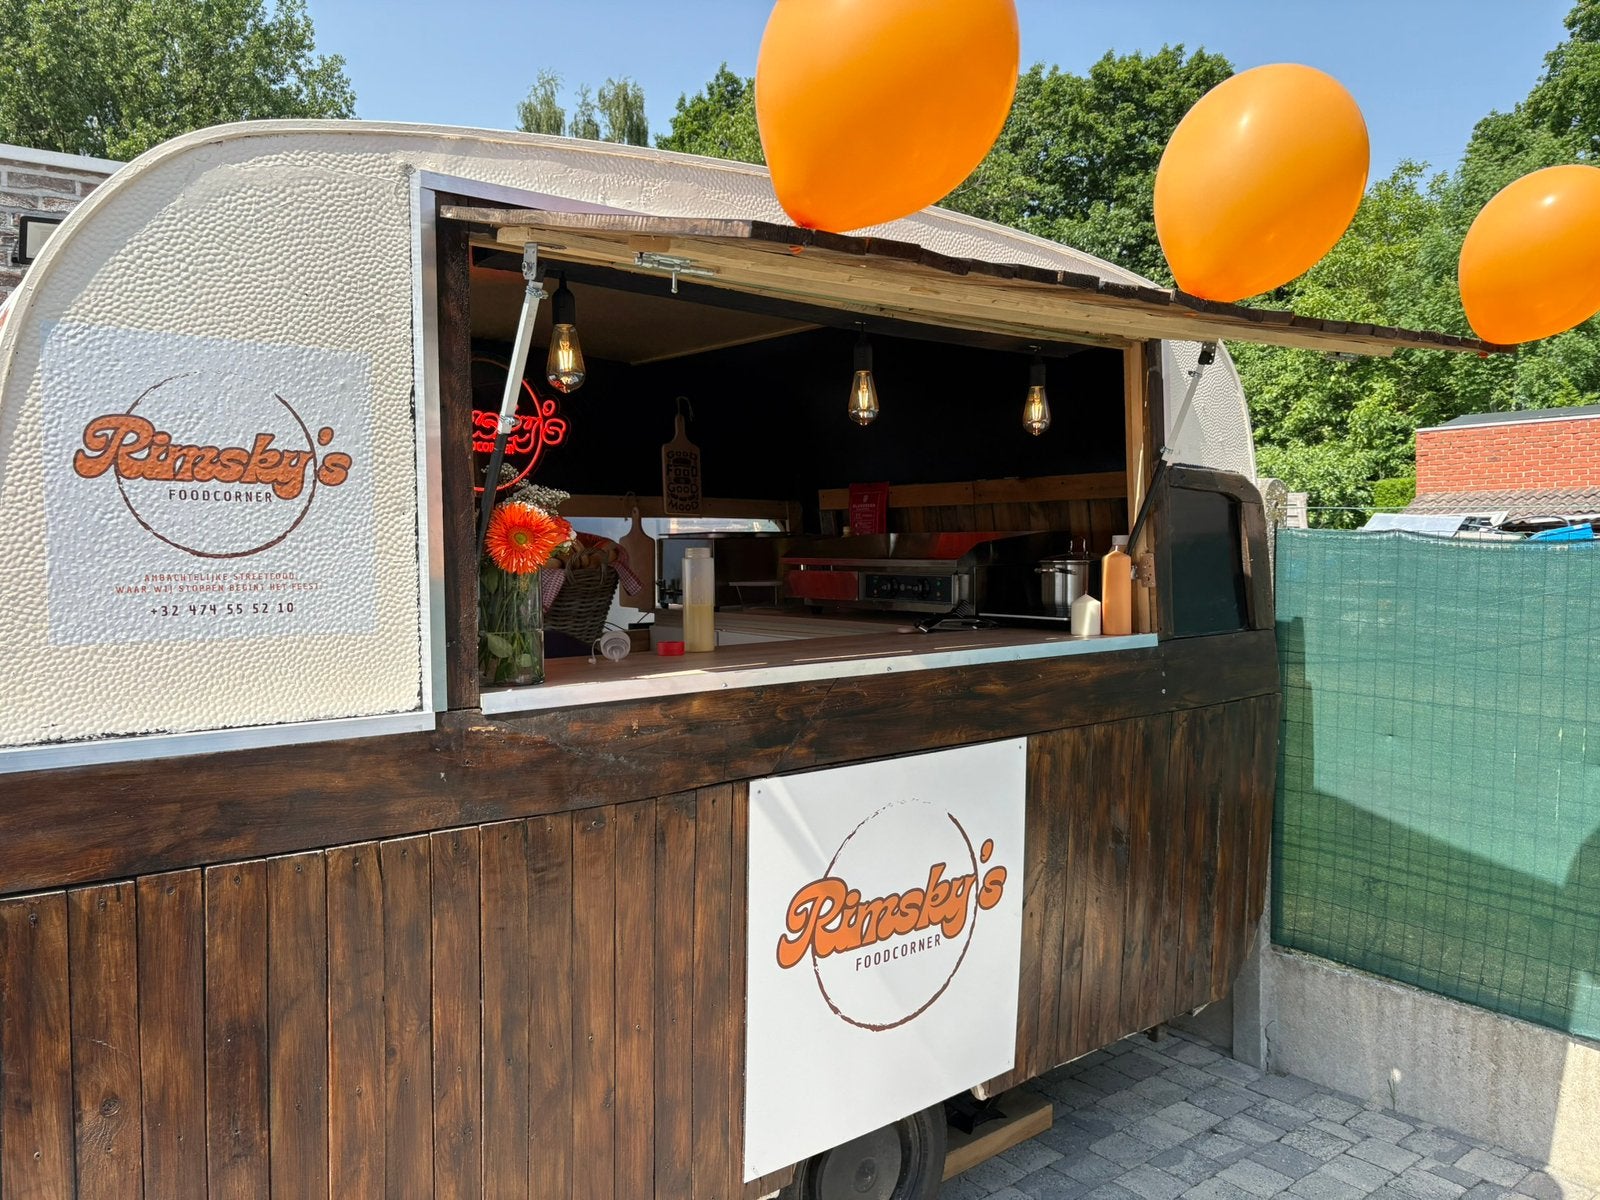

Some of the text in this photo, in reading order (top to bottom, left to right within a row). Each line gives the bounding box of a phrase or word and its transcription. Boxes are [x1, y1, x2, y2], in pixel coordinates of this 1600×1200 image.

[73, 413, 352, 500] Rimsky's
[168, 489, 273, 503] FOODCORNER
[144, 573, 229, 582] AMBACHTELIJKE
[115, 585, 147, 594] WAAR
[153, 585, 173, 594] WIJ
[179, 584, 224, 592] STOPPEN
[229, 583, 265, 592] BEGINT
[269, 583, 287, 591] HET
[151, 602, 294, 617] +32 474 55 52 10
[776, 838, 1007, 969] Rimsky's
[855, 933, 942, 972] FOODCORNER
